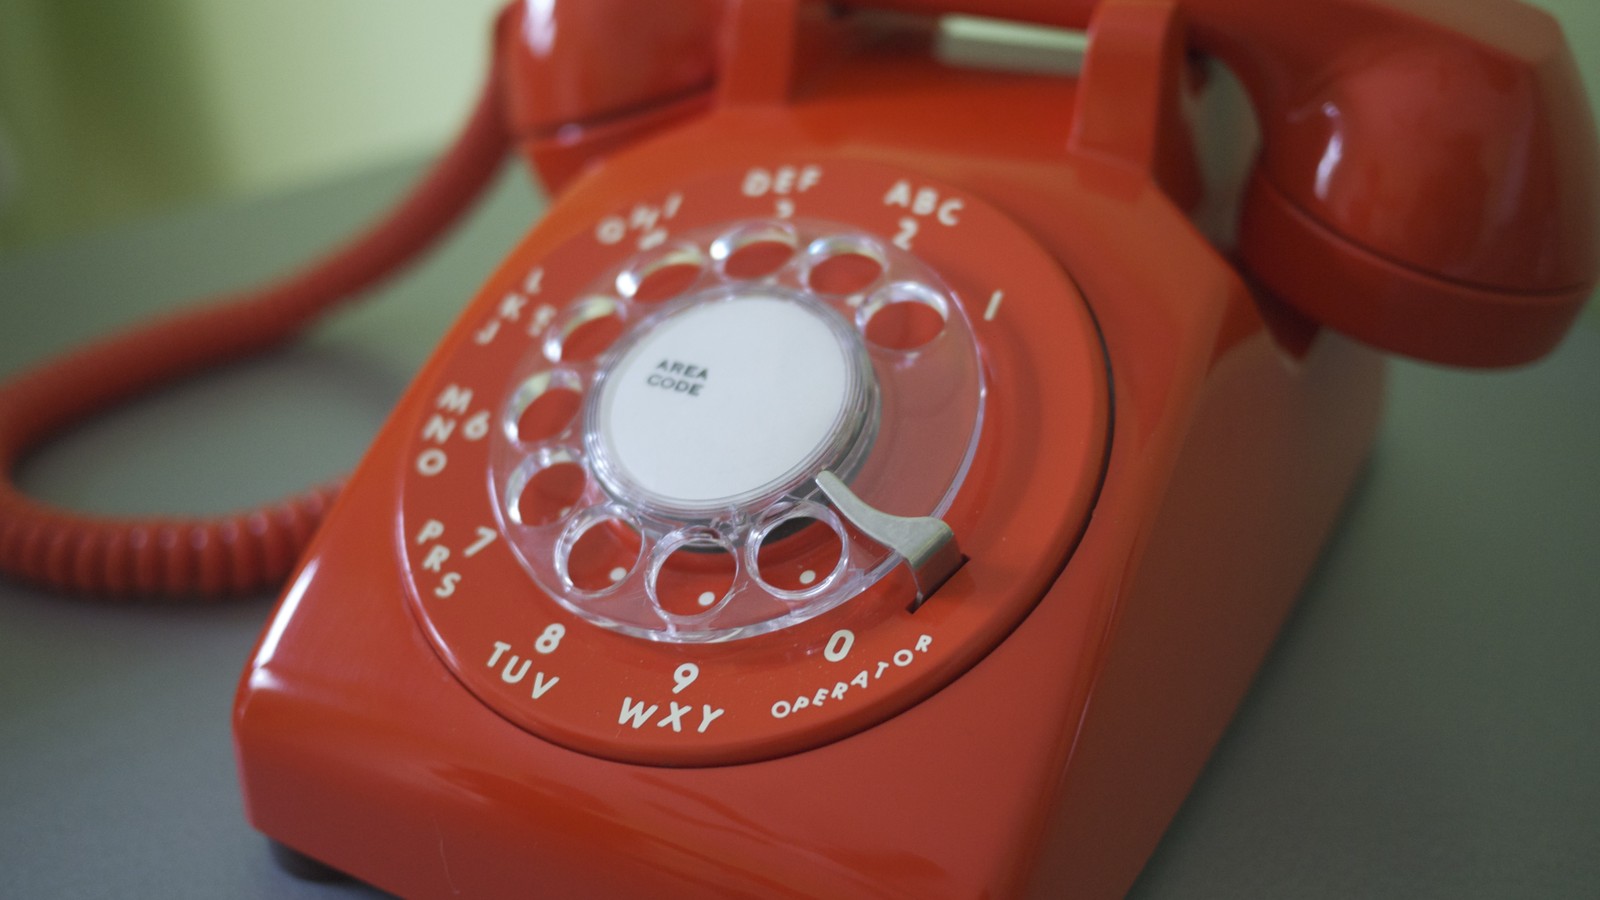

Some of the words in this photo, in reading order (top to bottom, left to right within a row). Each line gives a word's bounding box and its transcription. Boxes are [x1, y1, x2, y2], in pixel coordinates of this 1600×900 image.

[742, 165, 822, 197] DEF
[884, 181, 963, 226] ABC
[893, 218, 918, 250] 2
[646, 374, 704, 397] CODE
[656, 359, 708, 380] AREA
[463, 410, 490, 440] 6
[464, 525, 497, 557] 7
[417, 519, 461, 598] PRS
[535, 623, 566, 654] 8
[486, 641, 560, 699] TUV
[672, 663, 699, 694] 9
[771, 634, 932, 718] OPERATOR
[618, 697, 724, 733] WXY
